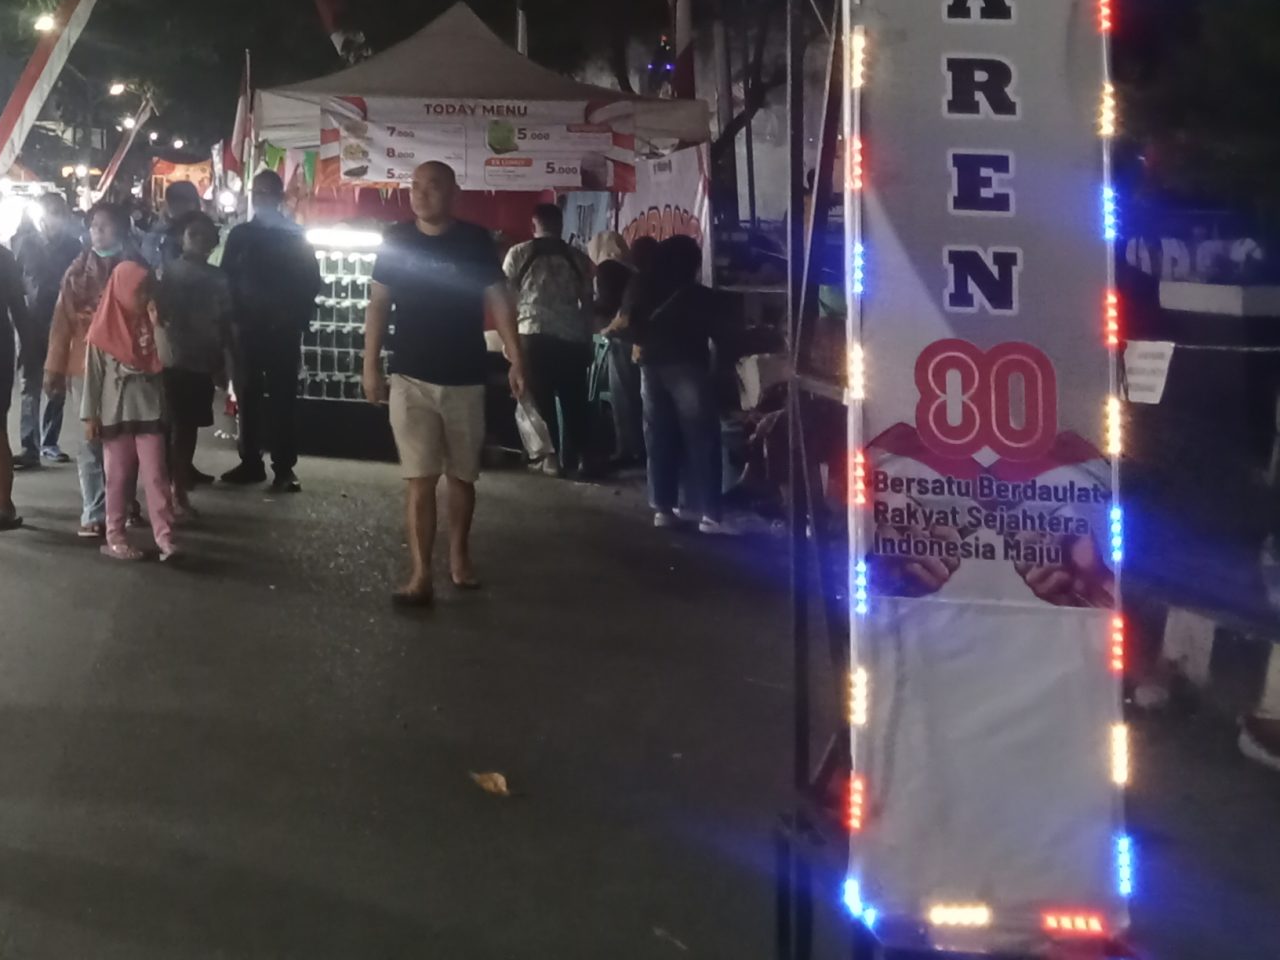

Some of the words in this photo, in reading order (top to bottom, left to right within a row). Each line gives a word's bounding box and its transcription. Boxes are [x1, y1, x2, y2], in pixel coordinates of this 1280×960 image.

[423, 103, 475, 117] TODAY
[481, 103, 529, 118] MENU
[385, 167, 413, 181] 5.00
[914, 337, 1058, 463] 80
[873, 471, 972, 498] Bersatu
[977, 474, 1101, 504] Berdaulat
[873, 501, 960, 531] Rakyat
[966, 505, 1090, 536] Sejahtera
[873, 530, 997, 561] Indonesia
[1003, 538, 1063, 566] Maju
